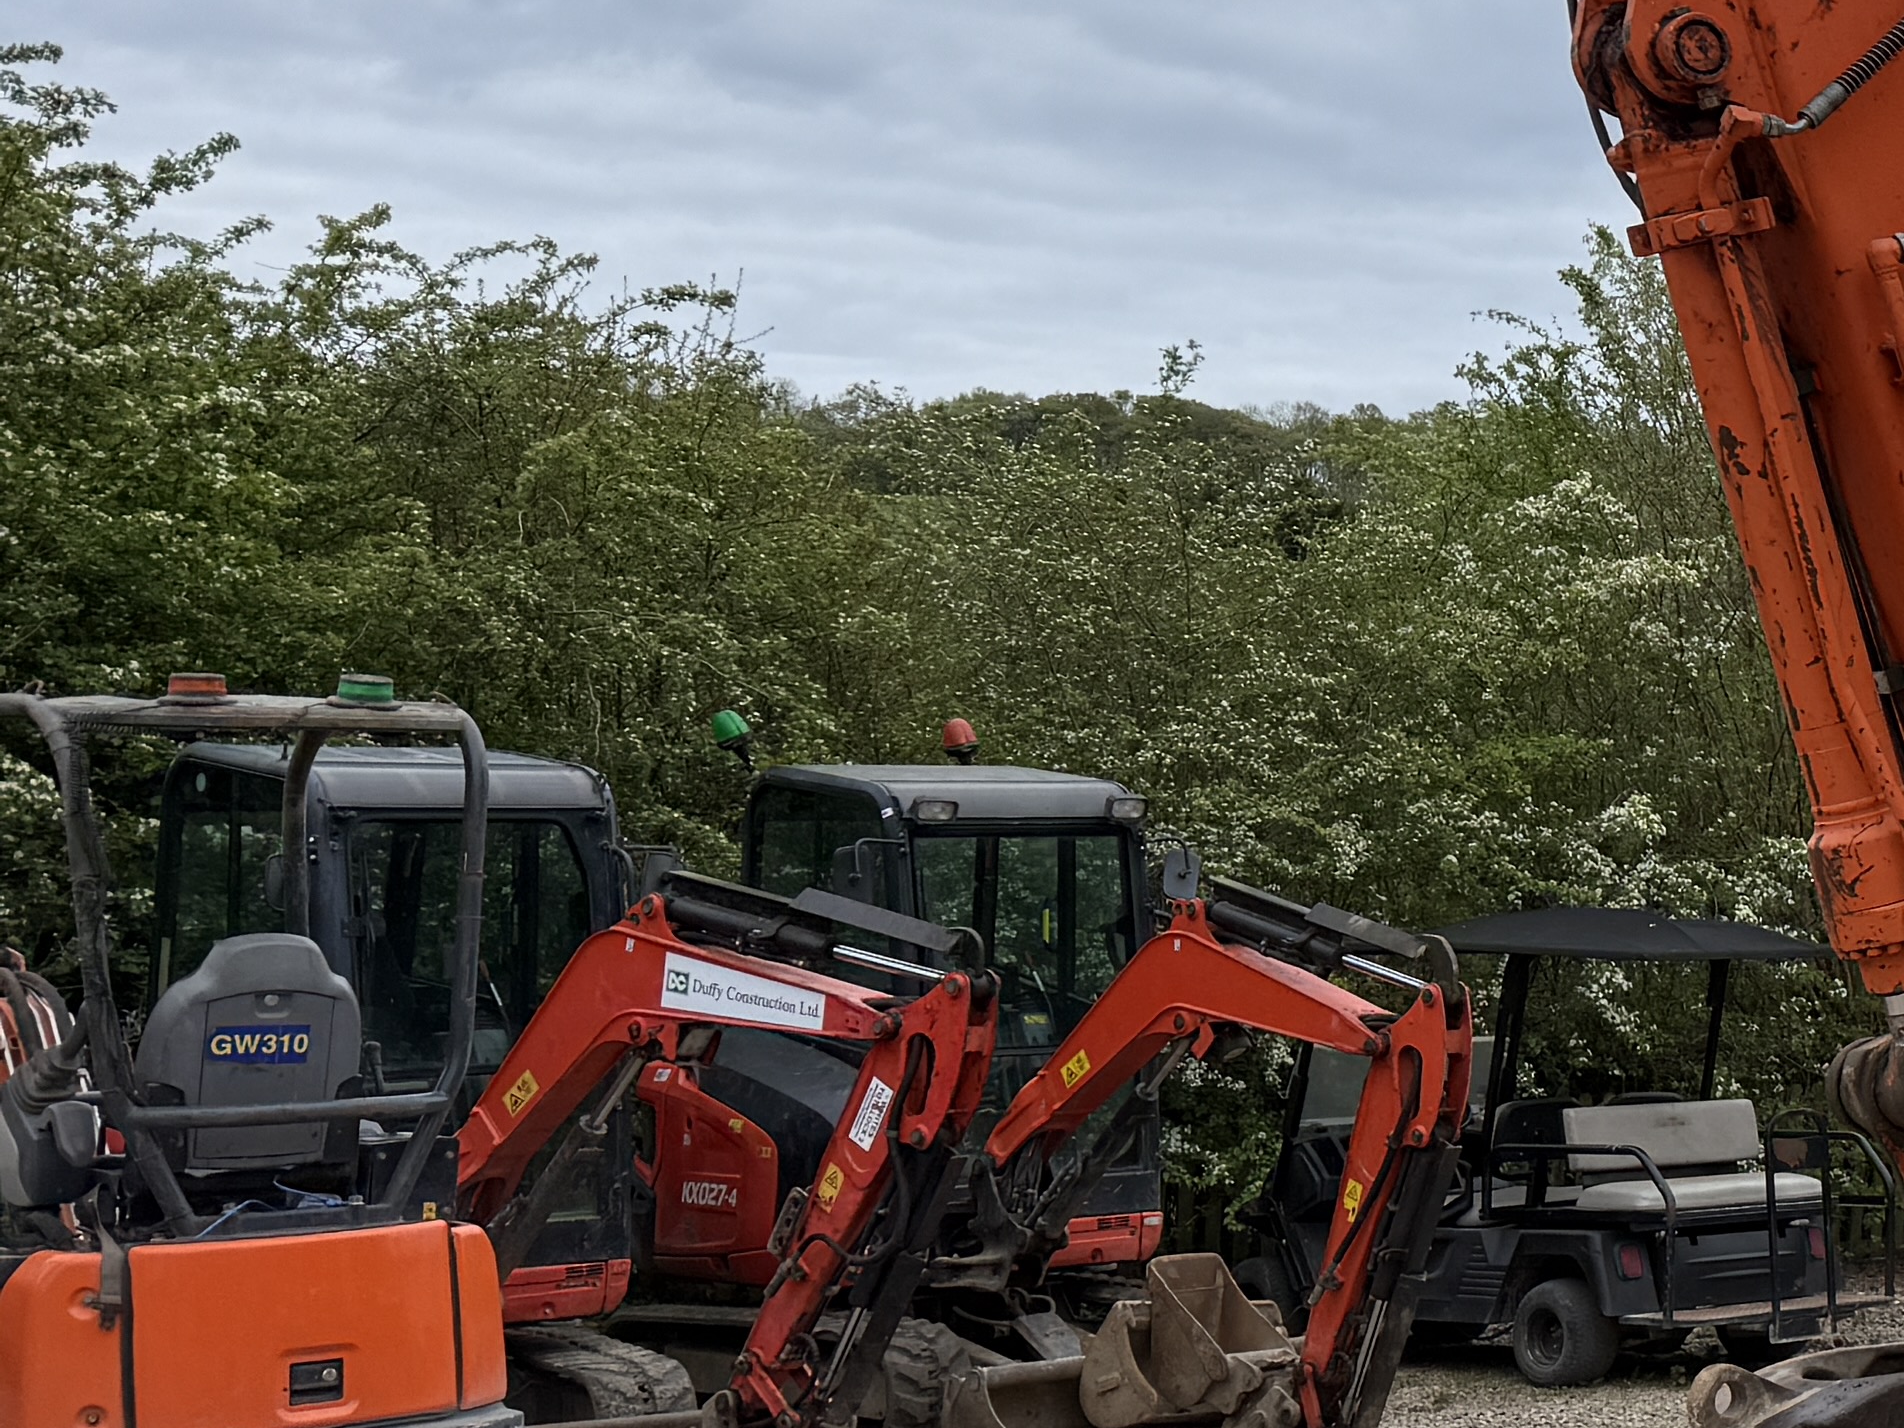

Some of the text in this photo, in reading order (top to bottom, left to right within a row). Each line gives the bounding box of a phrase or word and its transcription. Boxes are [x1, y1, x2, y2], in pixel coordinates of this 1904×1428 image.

[692, 979, 723, 1001] Duffy
[726, 986, 796, 1014] Construction
[210, 1034, 309, 1055] GW310
[681, 1181, 737, 1207] KX027-4
